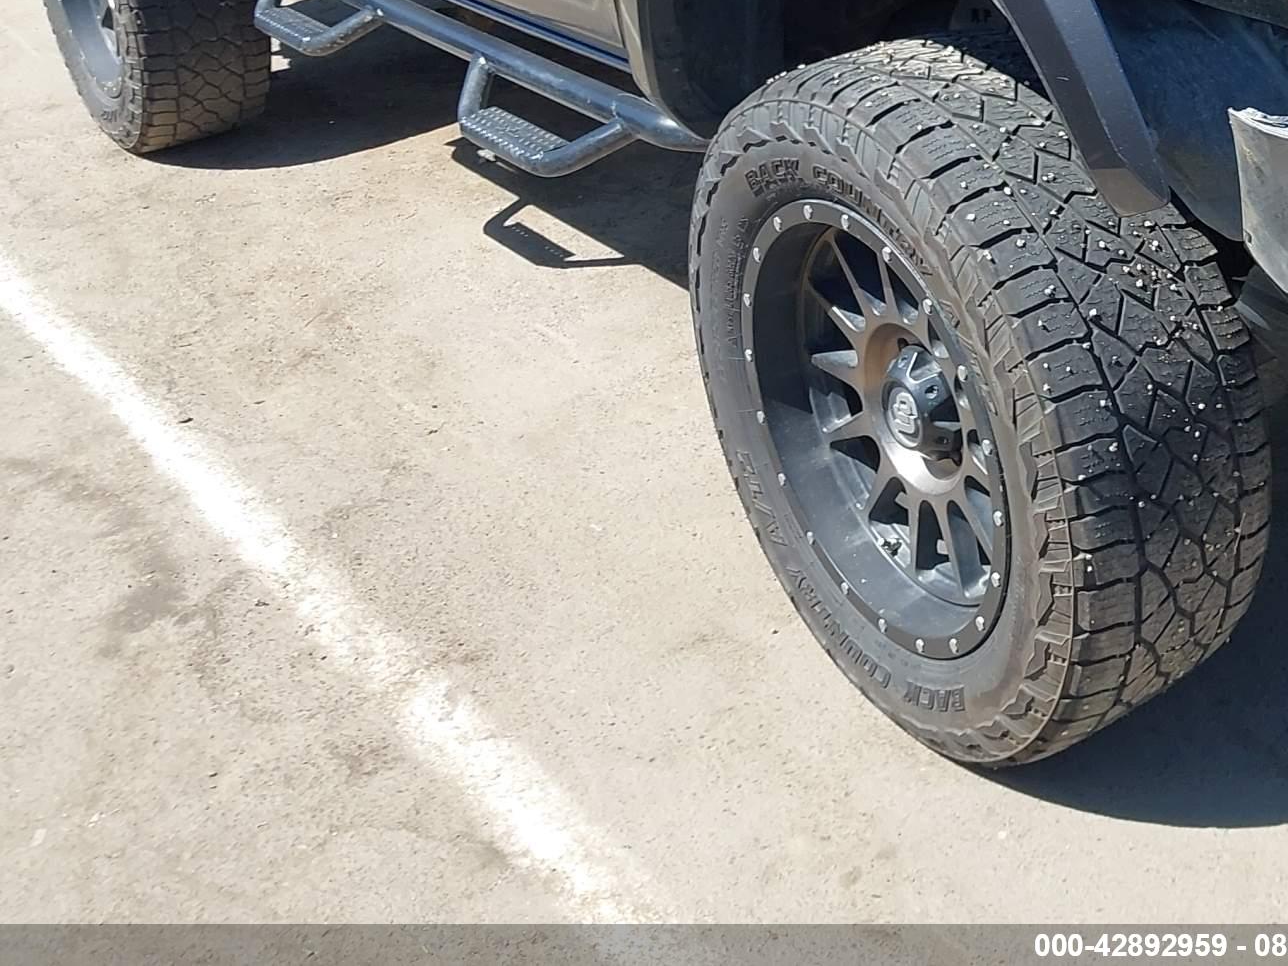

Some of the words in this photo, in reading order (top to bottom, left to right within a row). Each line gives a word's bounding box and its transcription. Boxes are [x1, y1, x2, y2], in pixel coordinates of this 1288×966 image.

[744, 158, 800, 195] BACK
[786, 567, 892, 689] COUNTRY
[904, 682, 967, 712] BACK
